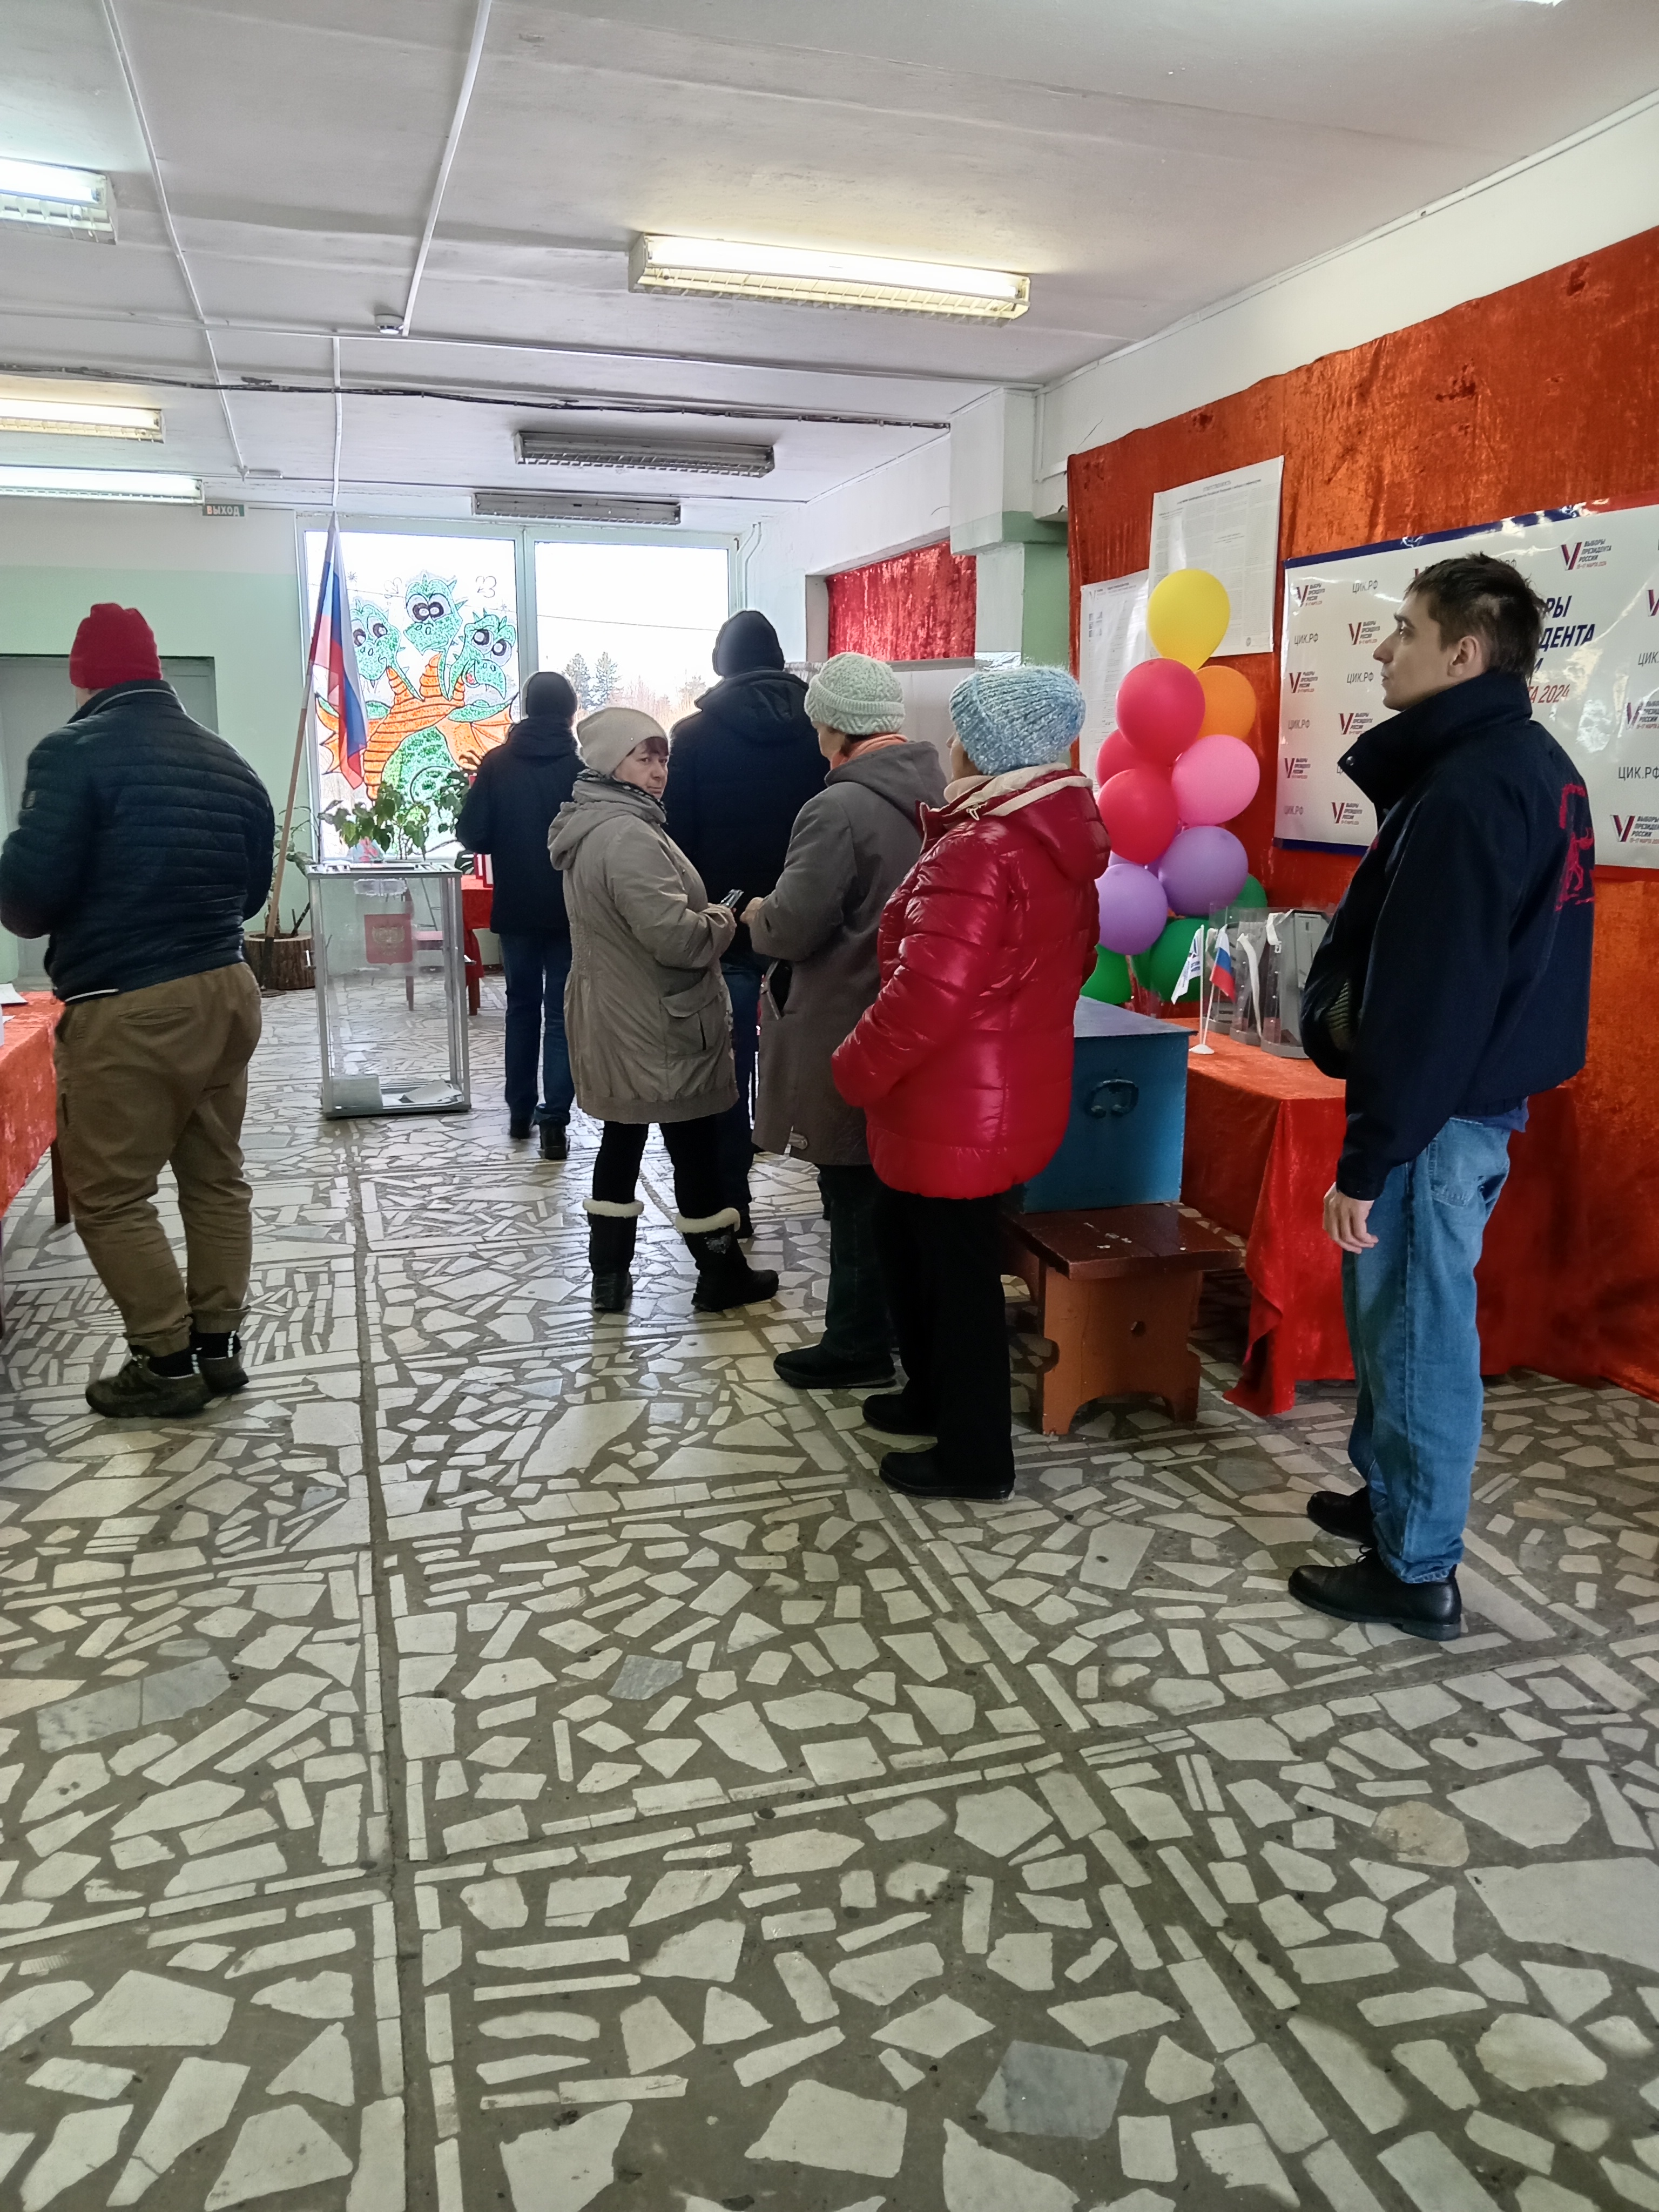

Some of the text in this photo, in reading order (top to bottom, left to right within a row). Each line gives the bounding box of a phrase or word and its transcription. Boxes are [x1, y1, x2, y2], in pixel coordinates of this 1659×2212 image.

[206, 505, 240, 517] ВЫХОД
[1581, 545, 1612, 555] ПРЕЗИДЕНТА
[1584, 539, 1606, 547] ВЫБОРЫ
[1352, 580, 1378, 594] ЦИК.РФ
[1294, 633, 1318, 646] ЦИК.РФ
[1538, 624, 1595, 652] ДЕНТА
[1638, 651, 1659, 667] ЦИК.
[1347, 671, 1374, 685] ЦИК.РФ
[1537, 684, 1570, 703] 2024
[1618, 766, 1659, 781] ЦИК.РФ
